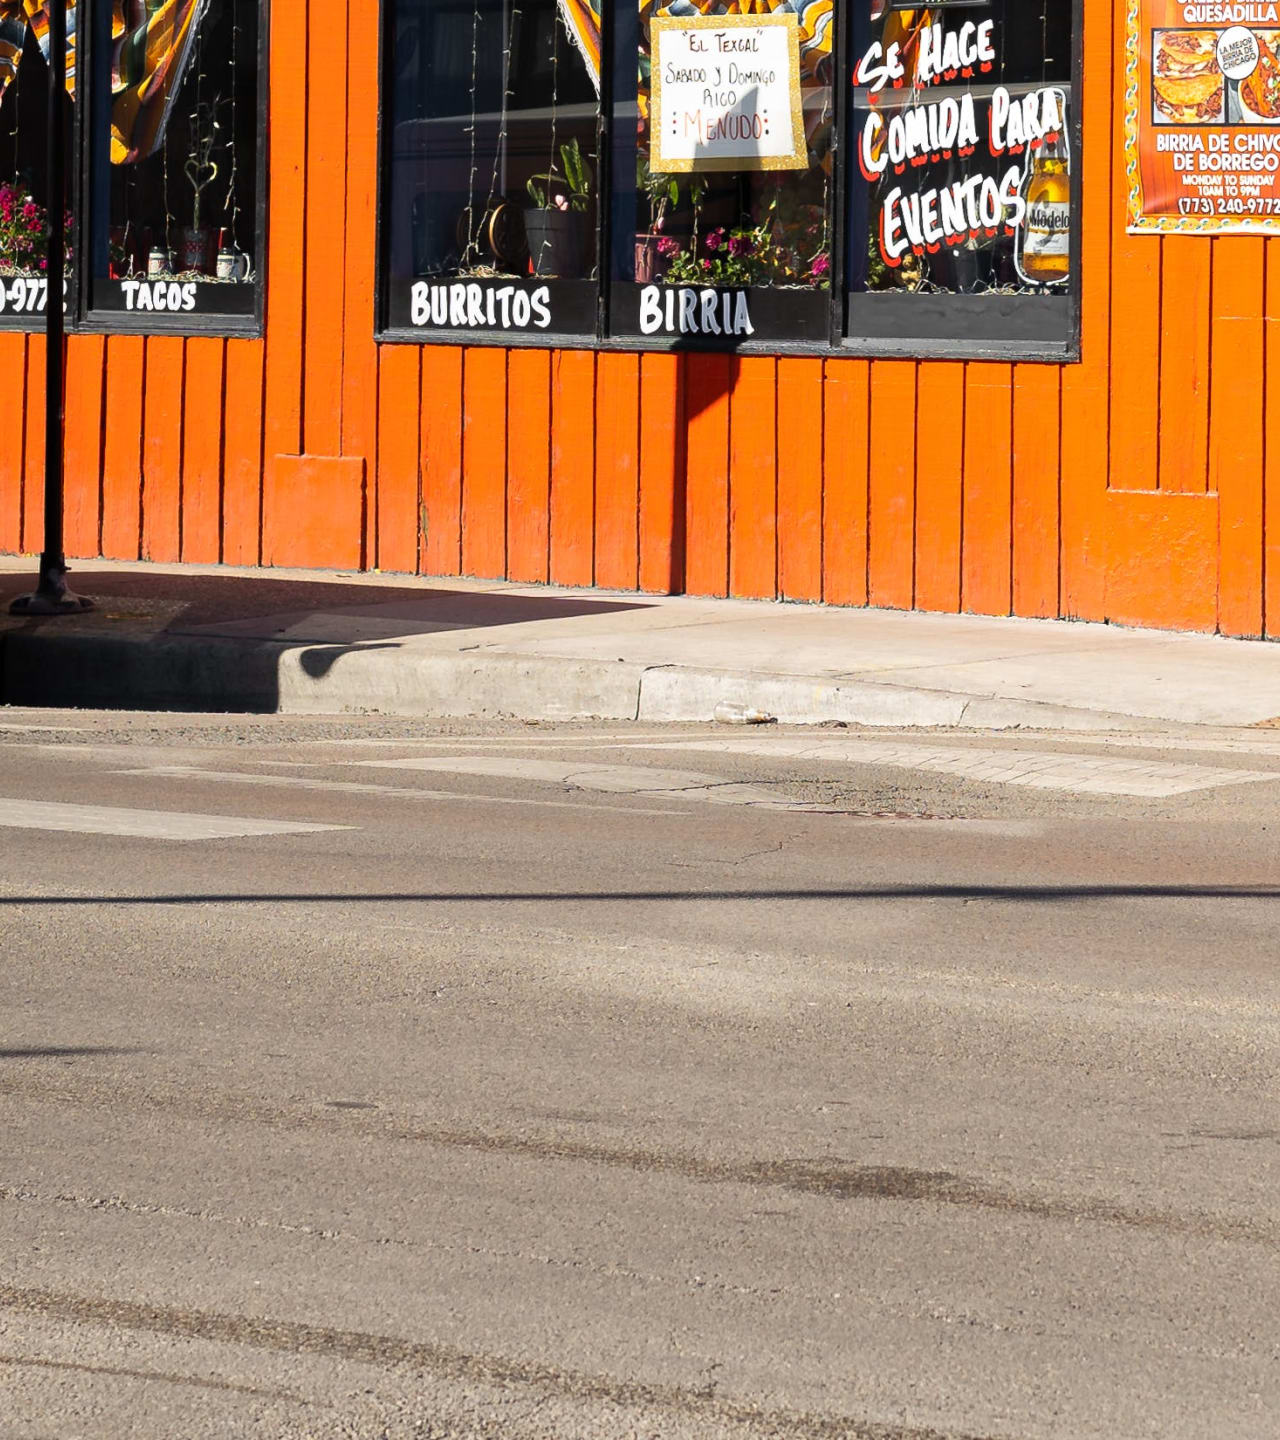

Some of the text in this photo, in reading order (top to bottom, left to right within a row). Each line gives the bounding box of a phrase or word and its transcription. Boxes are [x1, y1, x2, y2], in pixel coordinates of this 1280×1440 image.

[1183, 4, 1279, 23] QUESADILLA
[1222, 52, 1257, 70] CHICAGO
[665, 62, 706, 85] SABADO
[728, 62, 776, 88] DOMINGO
[684, 109, 762, 146] MENUDO
[862, 86, 1062, 174] COMIDA PARA
[1156, 134, 1204, 153] BIRRIA
[1208, 134, 1230, 152] DE
[1173, 152, 1280, 172] DE BORREGO
[1182, 174, 1276, 186] MONDAY TO SUNDAY
[1198, 186, 1260, 196] 10AM TO 9PM
[883, 165, 1026, 259] EVENTOS
[1178, 197, 1214, 216] (773)
[1030, 209, 1070, 228] Modelo
[121, 280, 197, 311] TACOS
[410, 280, 552, 329] BURRITOS
[640, 285, 755, 336] BIRRIA
